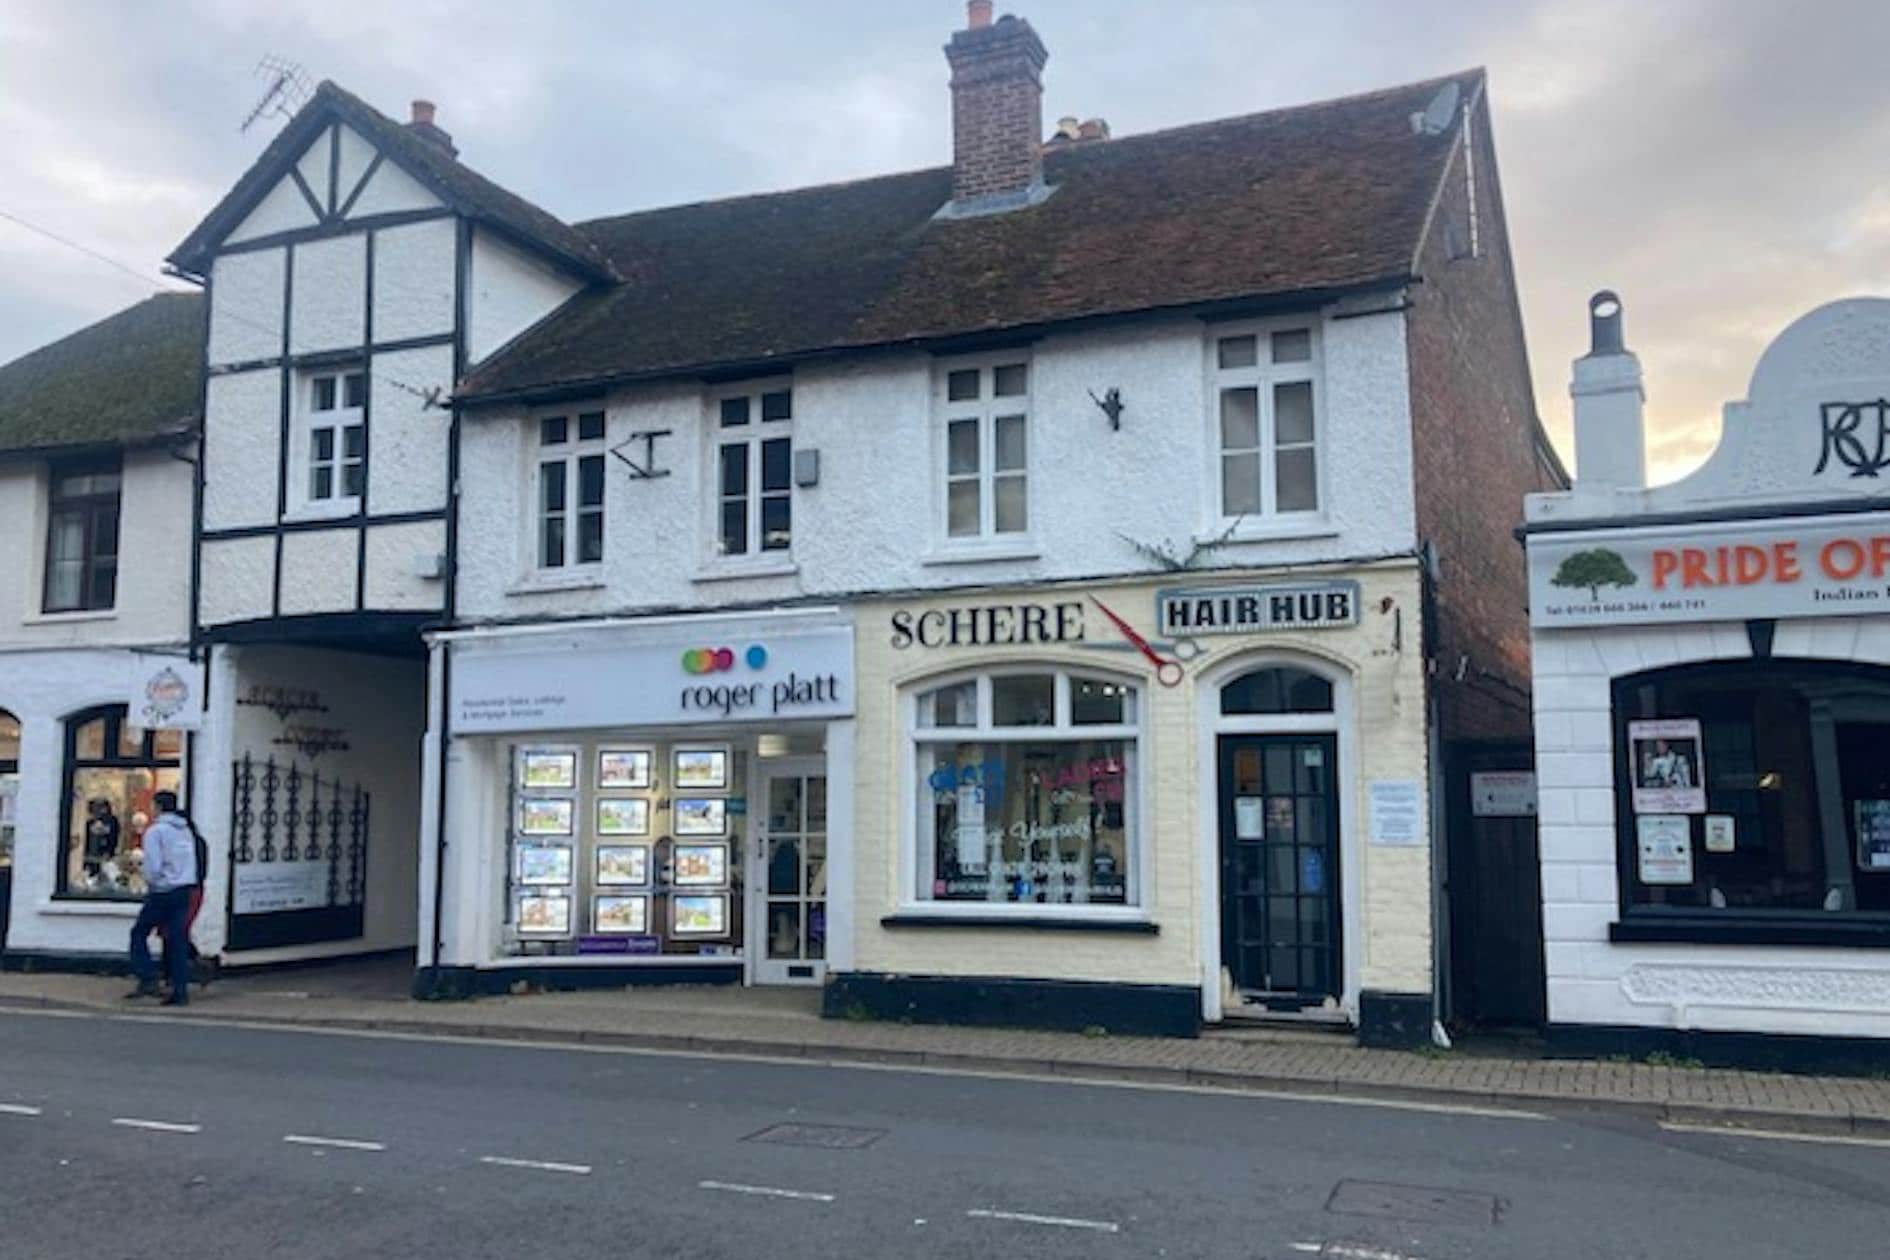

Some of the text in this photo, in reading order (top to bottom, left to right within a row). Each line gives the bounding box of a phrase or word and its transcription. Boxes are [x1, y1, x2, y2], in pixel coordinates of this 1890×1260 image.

[1652, 535, 1890, 592] PRIDE OF
[1167, 593, 1350, 628] HAIR HUB
[1814, 587, 1880, 602] Indian
[891, 601, 1085, 649] SCHERE
[681, 670, 841, 715] roger platt
